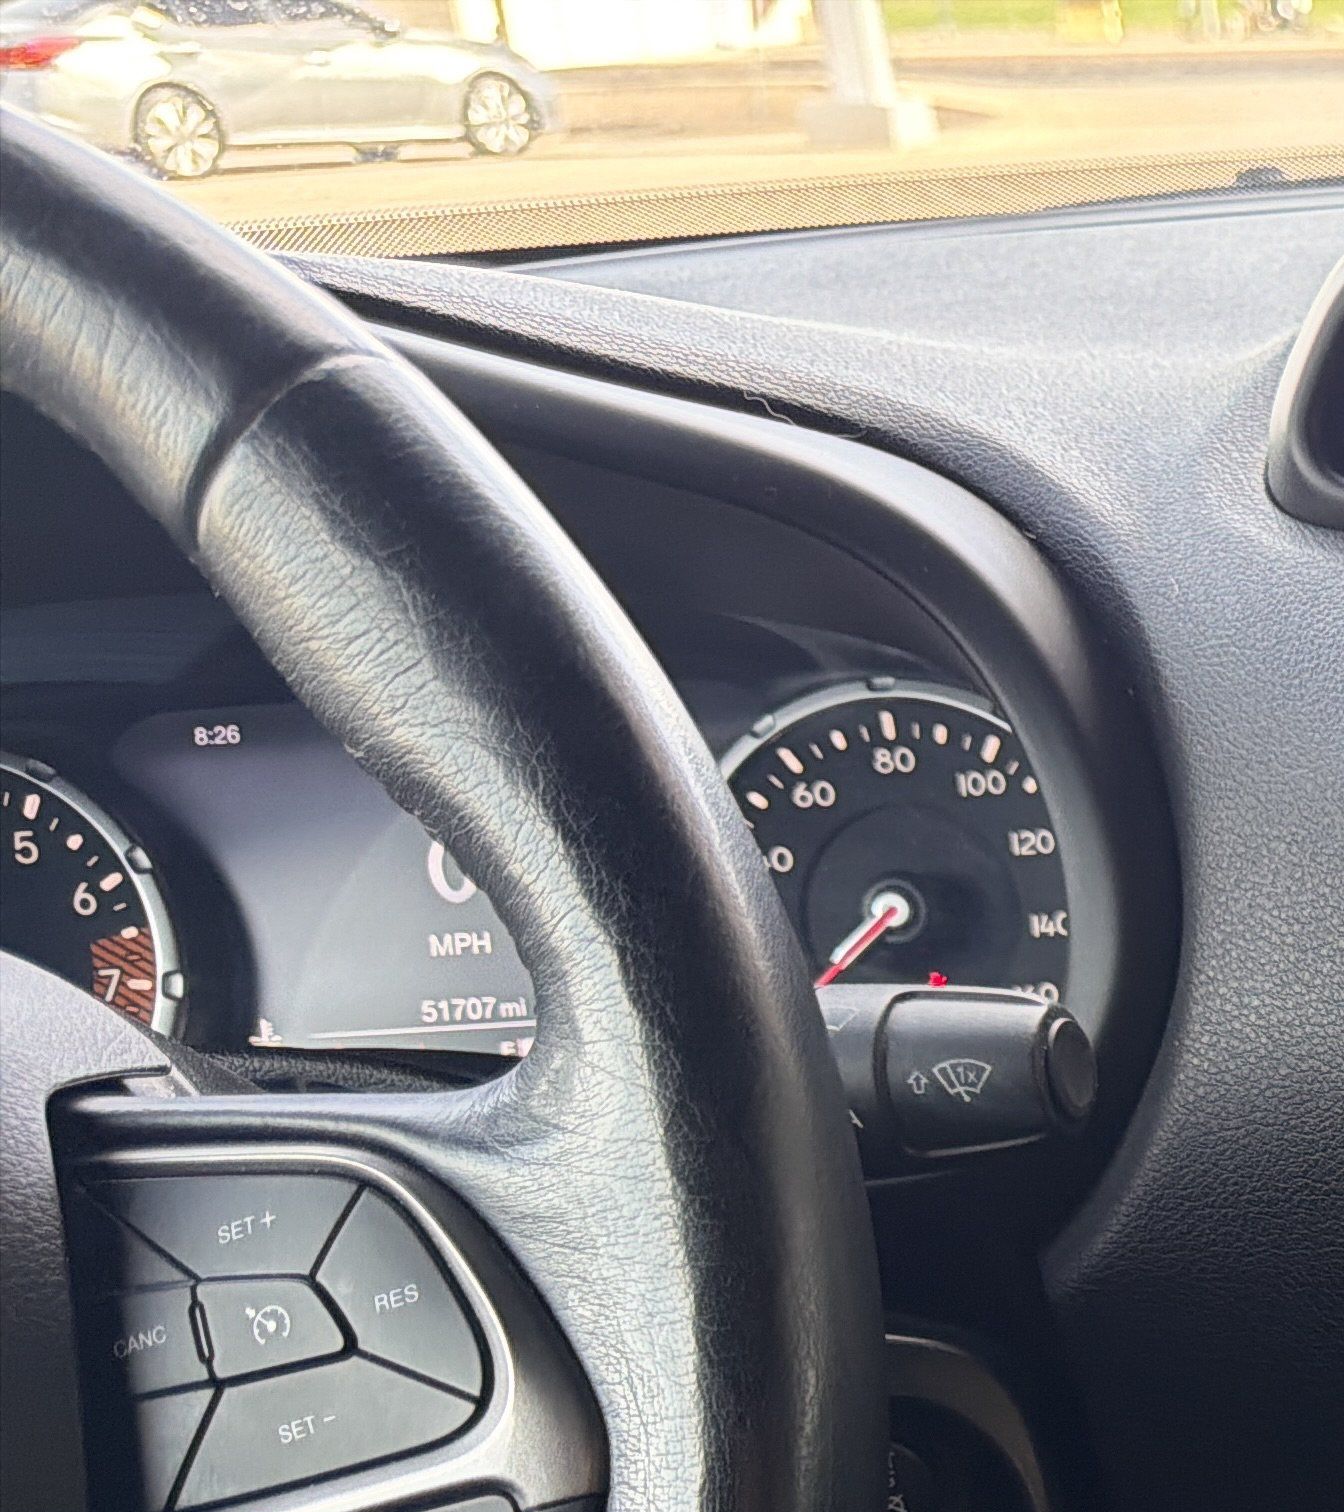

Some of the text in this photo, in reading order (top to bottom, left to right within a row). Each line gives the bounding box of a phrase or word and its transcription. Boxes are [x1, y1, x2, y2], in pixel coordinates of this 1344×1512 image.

[194, 725, 241, 746] 8:26
[873, 747, 915, 774] 80
[792, 781, 836, 808] 60
[955, 769, 1006, 797] 100
[13, 830, 39, 864] 5
[1009, 829, 1056, 857] 120
[73, 883, 98, 916] 6
[428, 930, 493, 957] MPH
[97, 968, 121, 1002] 7
[421, 996, 497, 1022] 51707
[217, 1217, 256, 1245] SET
[373, 1284, 420, 1313] RES
[112, 1326, 168, 1361] CANC
[277, 1416, 317, 1444] SET
